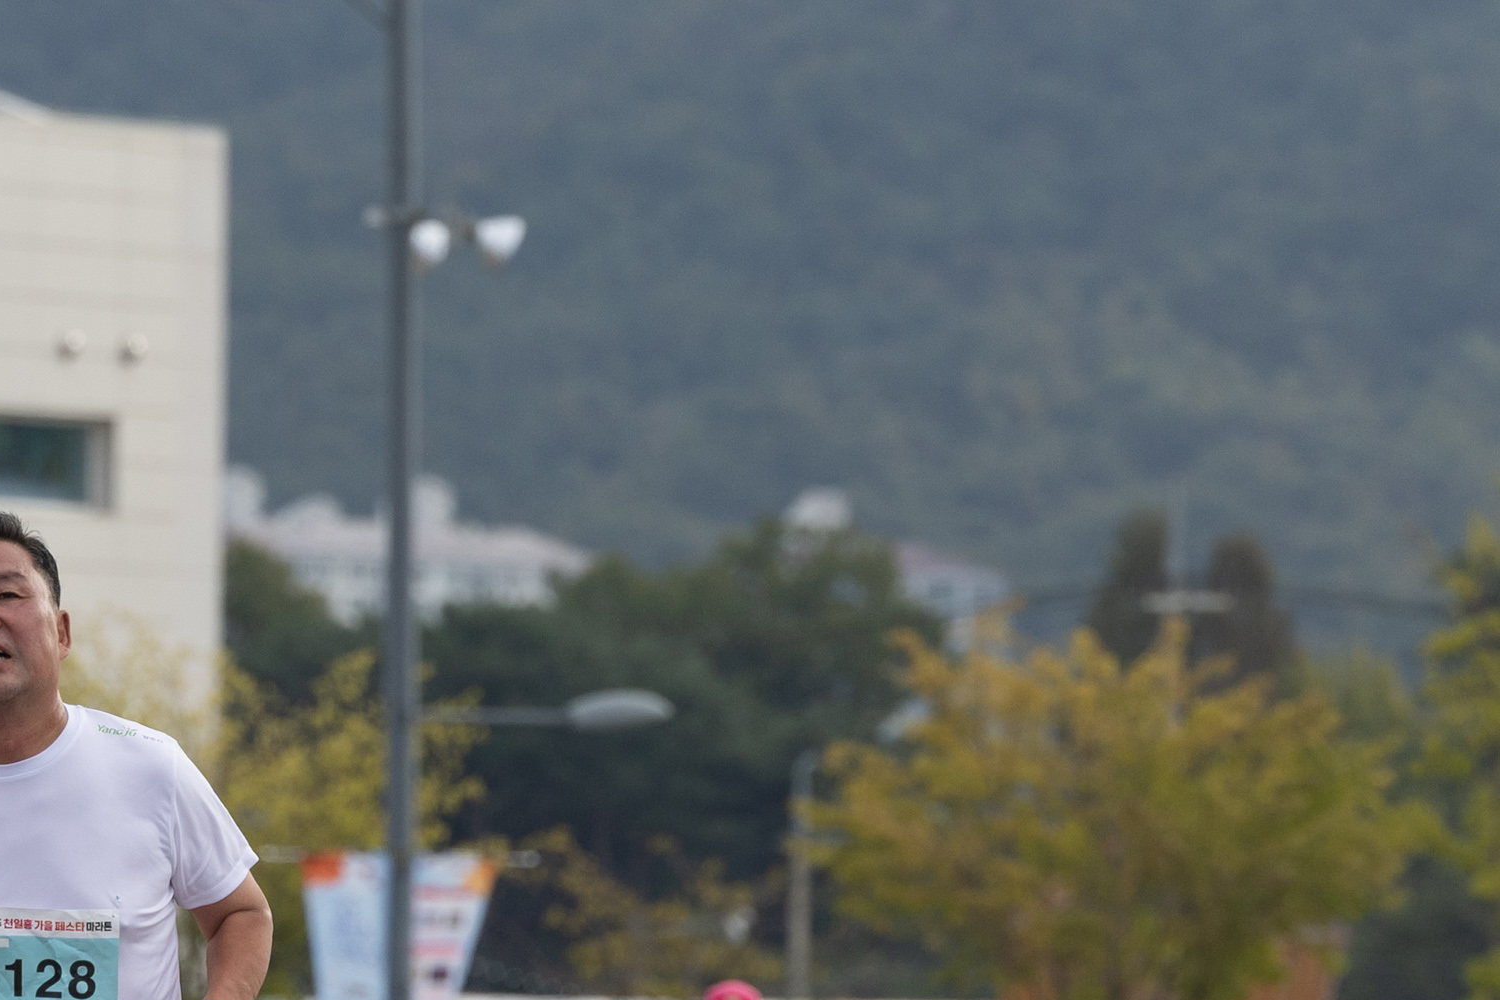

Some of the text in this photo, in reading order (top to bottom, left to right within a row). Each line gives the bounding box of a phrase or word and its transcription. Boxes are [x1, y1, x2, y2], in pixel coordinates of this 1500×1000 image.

[3, 918, 33, 930] 천일홍
[34, 919, 53, 932] 가을
[55, 920, 85, 932] 페스타
[86, 921, 113, 932] 마라톤
